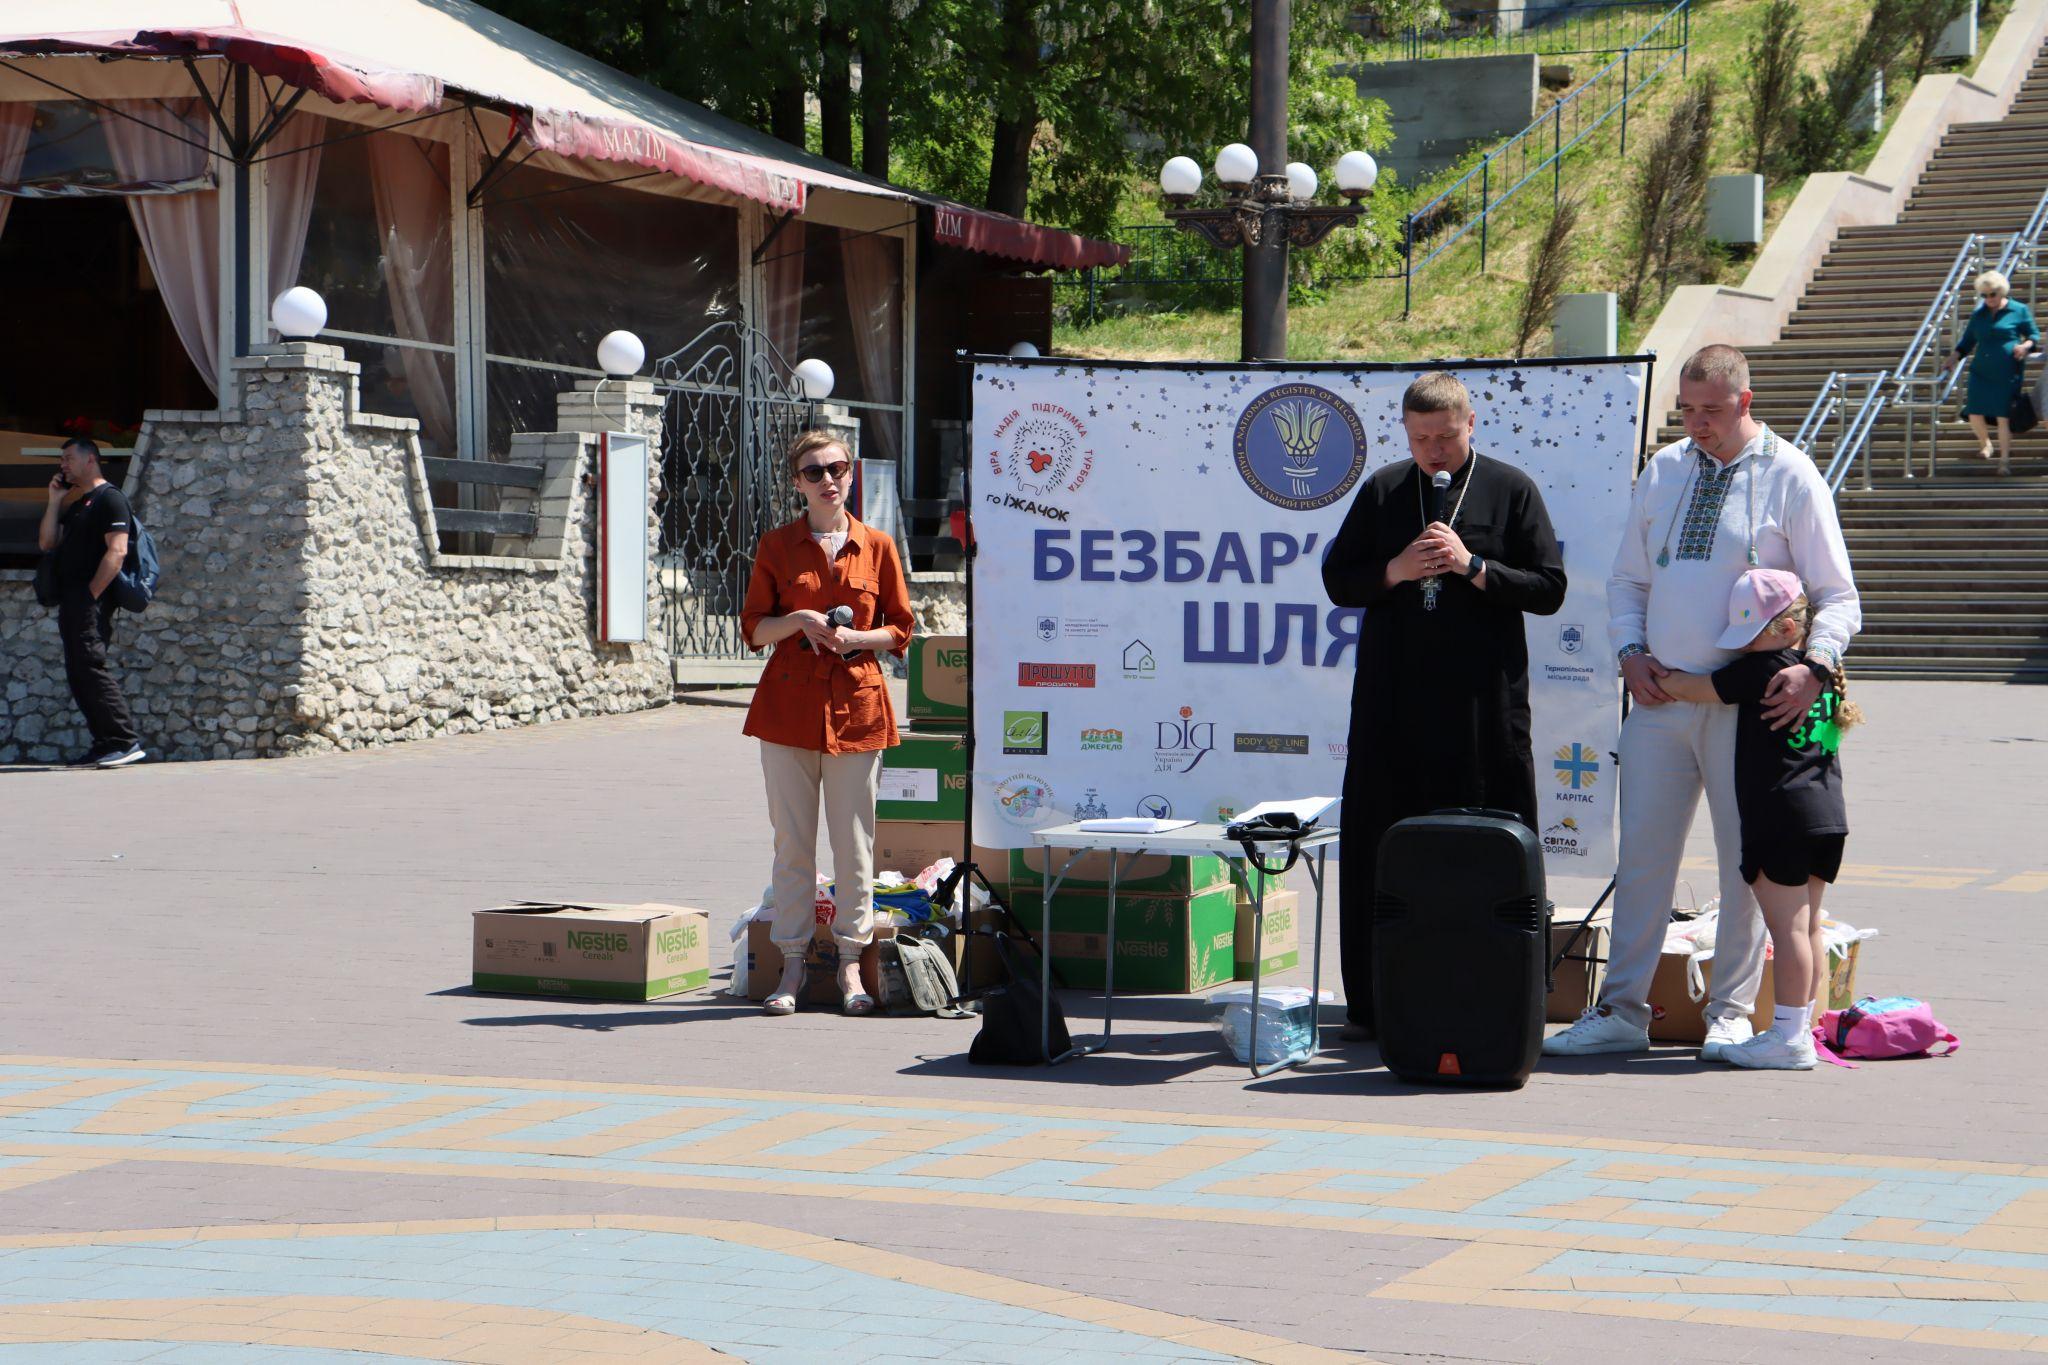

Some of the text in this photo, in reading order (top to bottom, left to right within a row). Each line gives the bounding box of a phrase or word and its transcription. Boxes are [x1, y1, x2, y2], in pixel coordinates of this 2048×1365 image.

[1237, 386, 1364, 441] NATIONAL REGISTER OF RECORDS
[990, 403, 1093, 492] ВІРА НАДІЯ ПІДТРИМКА ТУРБОТА
[1237, 451, 1365, 509] НАЦІОНАЛЬНИЙ РЕЄСТР РЕКОРДІВ
[1003, 492, 1070, 522] ЇЖАЧОК
[1034, 529, 1337, 584] БЕЗБАР'
[1020, 662, 1094, 681] ПРОШУТТО
[1545, 664, 1594, 674] Тернопільська
[1547, 673, 1571, 681] міська
[1081, 742, 1123, 751] ДЖЕРЕЛО
[1236, 737, 1306, 748] BODY LINE
[1556, 792, 1595, 803] КАРІТАС
[1539, 844, 1589, 857] ЕФОРМАЦІЇ
[582, 950, 614, 961] Cereals
[666, 950, 689, 964] Cereals
